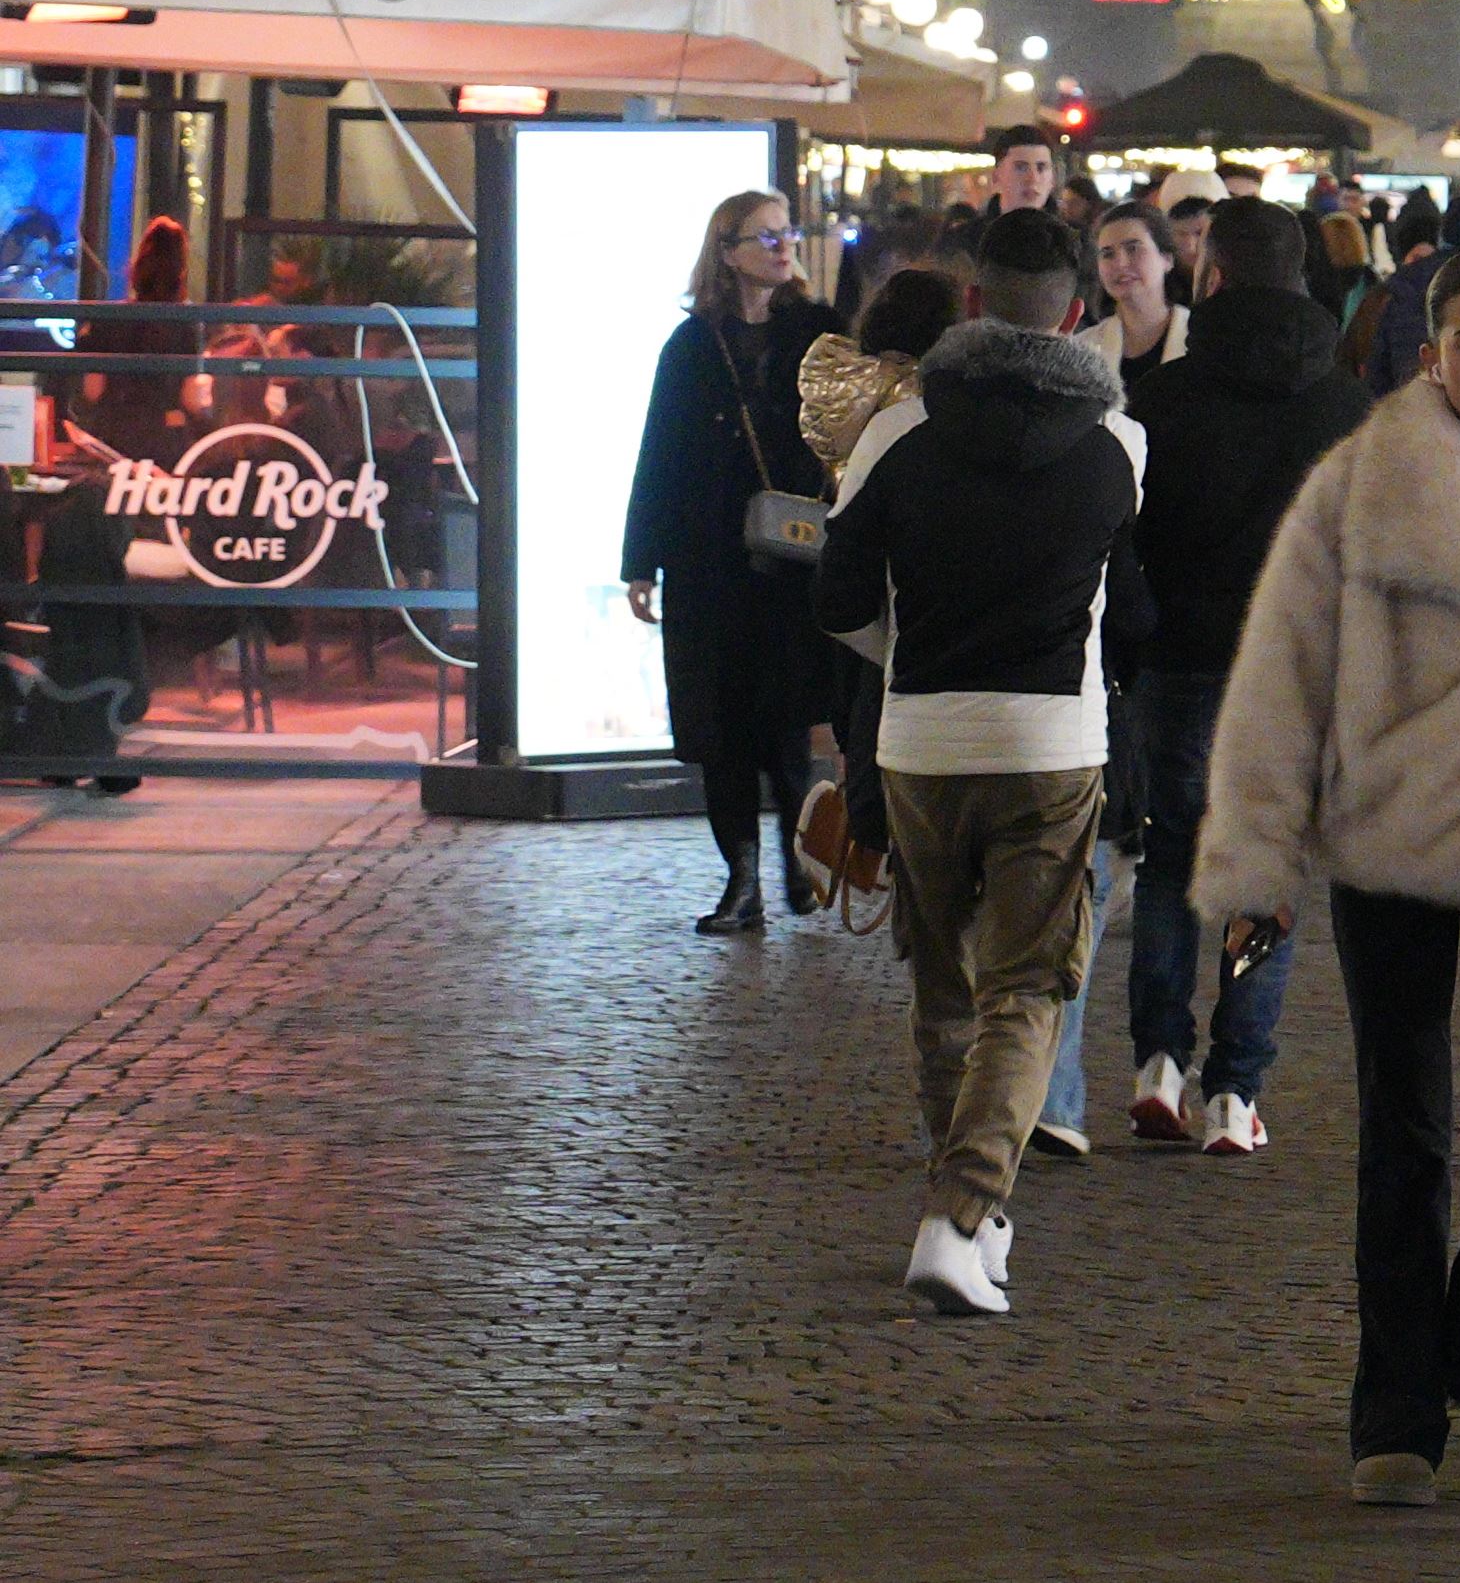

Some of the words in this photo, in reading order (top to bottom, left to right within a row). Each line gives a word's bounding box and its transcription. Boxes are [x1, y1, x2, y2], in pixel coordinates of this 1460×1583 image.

[104, 458, 251, 517] Hard
[252, 459, 390, 531] Rock
[213, 535, 287, 562] CAFE
